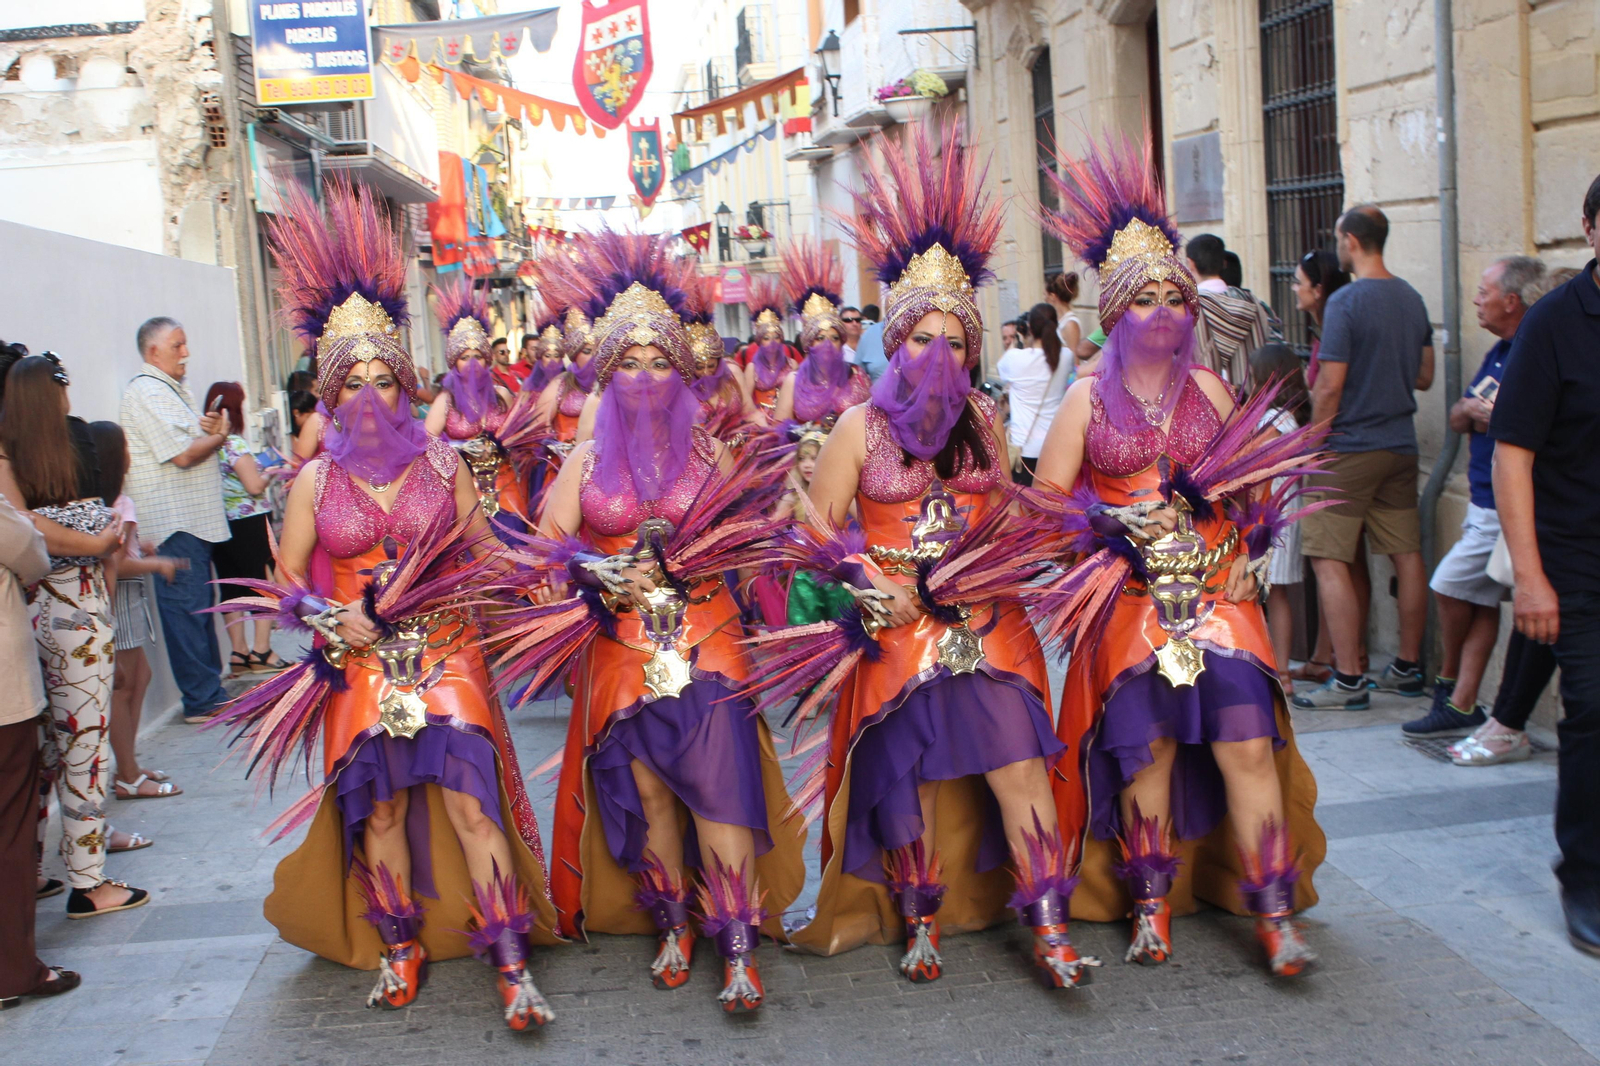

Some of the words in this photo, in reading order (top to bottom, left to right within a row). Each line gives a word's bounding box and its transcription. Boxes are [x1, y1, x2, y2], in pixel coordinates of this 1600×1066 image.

[260, 3, 300, 20] PLANES
[302, 1, 357, 18] PARCIALES
[285, 26, 338, 44] PARCELAS
[316, 50, 367, 67] RUSTICOS
